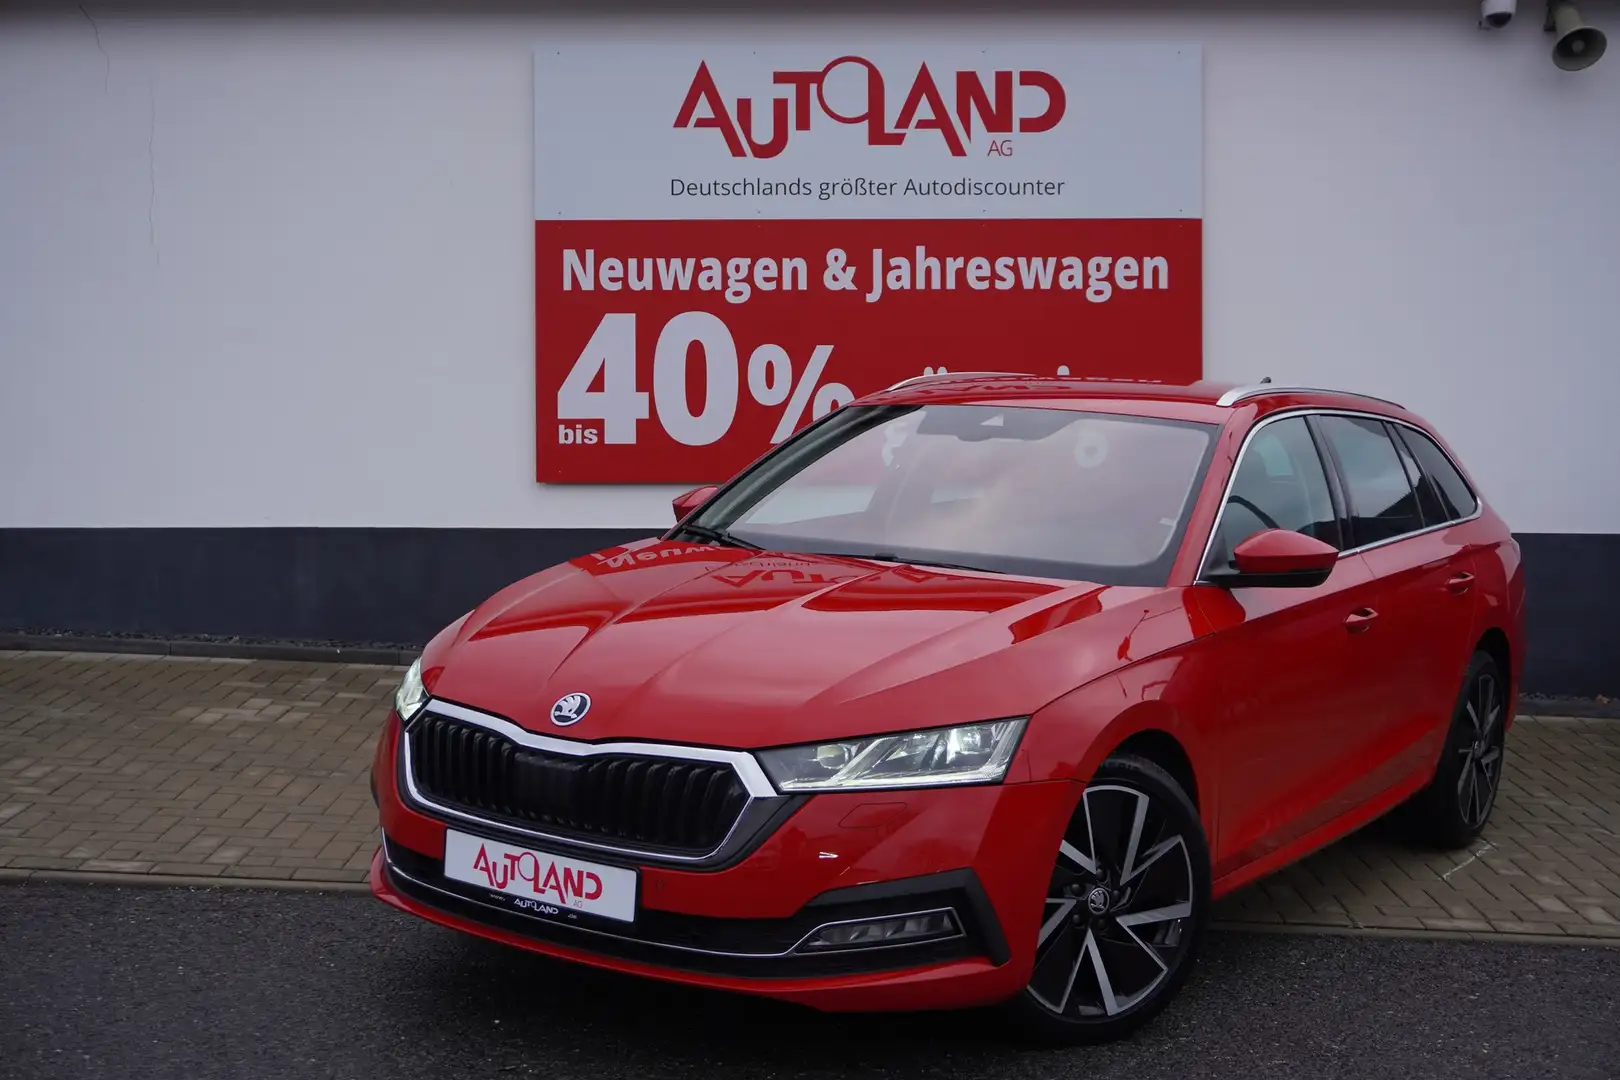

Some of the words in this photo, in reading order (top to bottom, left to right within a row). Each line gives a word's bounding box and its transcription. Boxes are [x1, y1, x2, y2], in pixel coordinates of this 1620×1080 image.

[673, 56, 1066, 159] AUTOLAND
[987, 139, 1013, 157] AG
[670, 177, 812, 197] Deutschlands
[818, 177, 898, 200] größter
[903, 177, 1065, 197] Autodiscounter
[562, 248, 808, 304] Neuwagen
[823, 247, 858, 291] &
[865, 245, 1169, 303] Jahreswagen
[557, 310, 853, 446] 40%
[558, 424, 598, 445] bis
[473, 843, 604, 904] AUTOLAND
[513, 898, 560, 915] AUTOLAND
